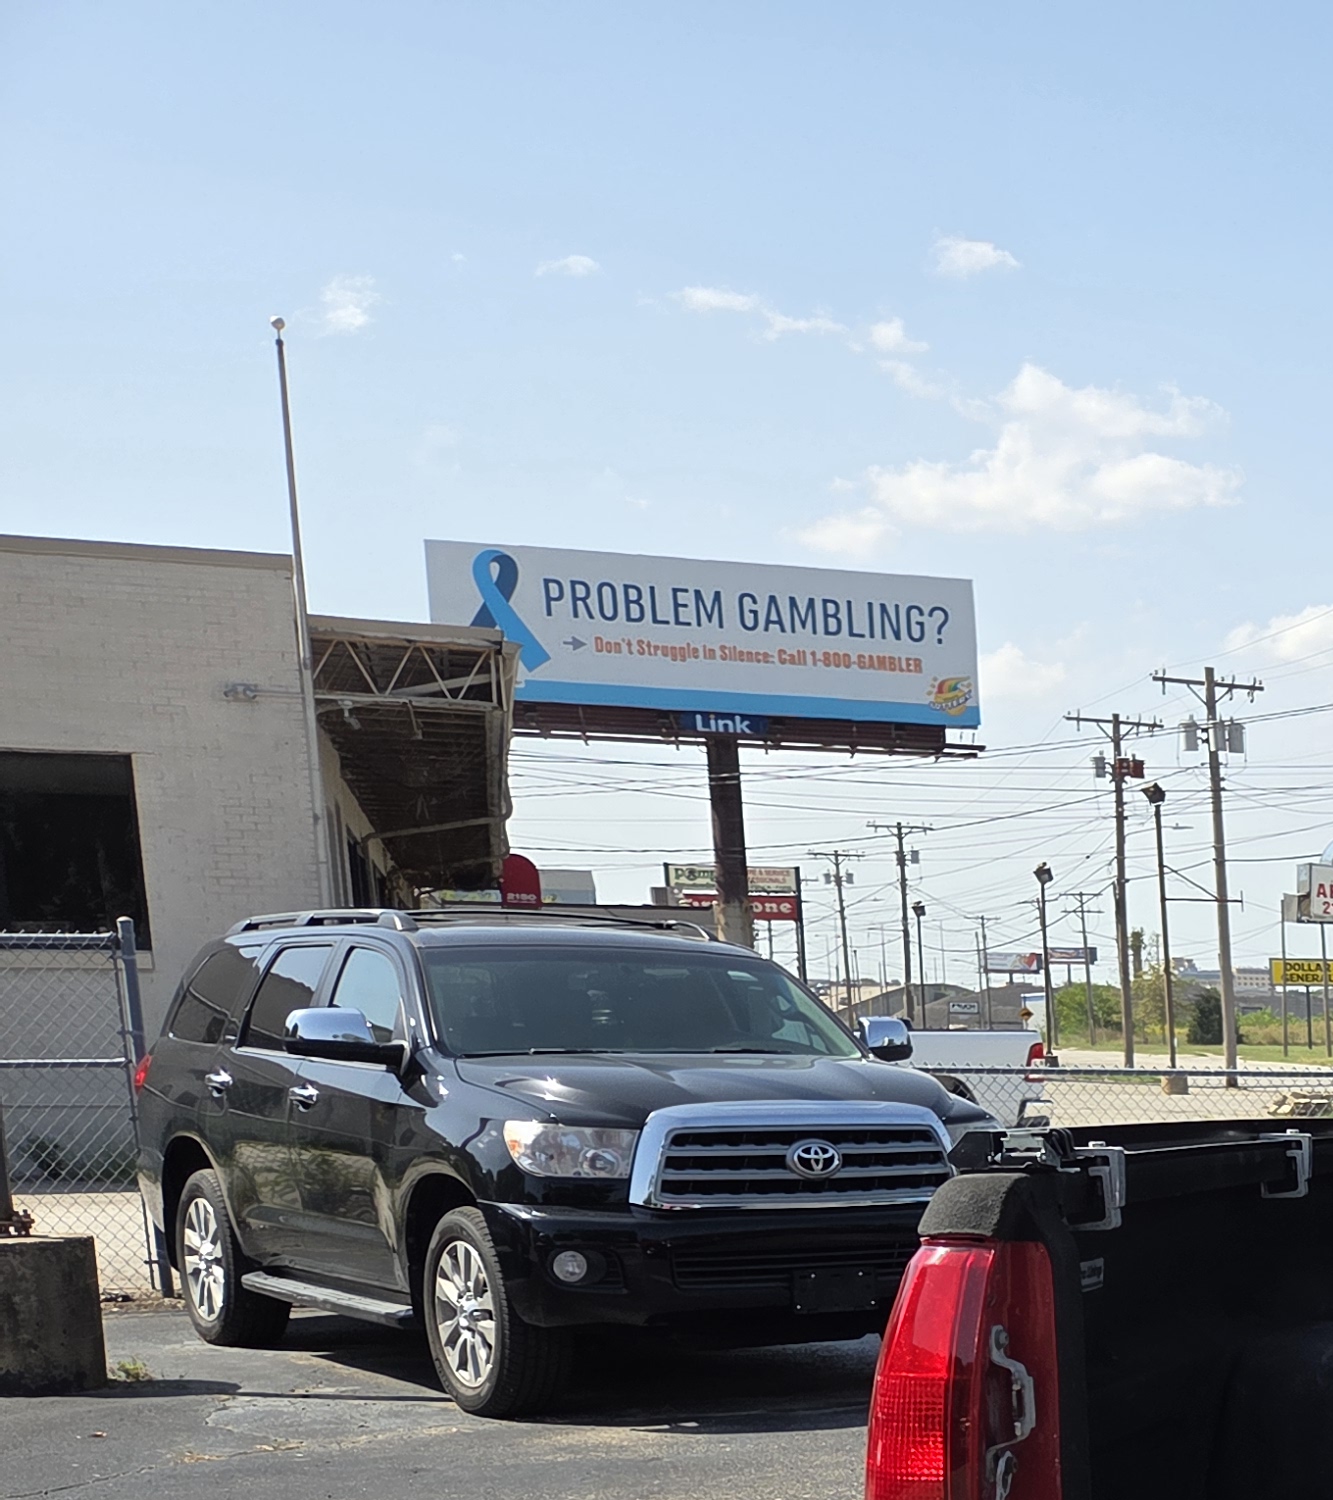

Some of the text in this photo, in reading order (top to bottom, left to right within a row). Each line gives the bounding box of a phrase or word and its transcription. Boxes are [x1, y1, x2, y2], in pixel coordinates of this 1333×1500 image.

[543, 578, 950, 645] PROBLEM GAMBLING?
[594, 636, 924, 674] Don't Struggle in Silence: Call 1-800-GAMBLER
[695, 713, 755, 734] Link
[1285, 962, 1332, 973] DOLLAR
